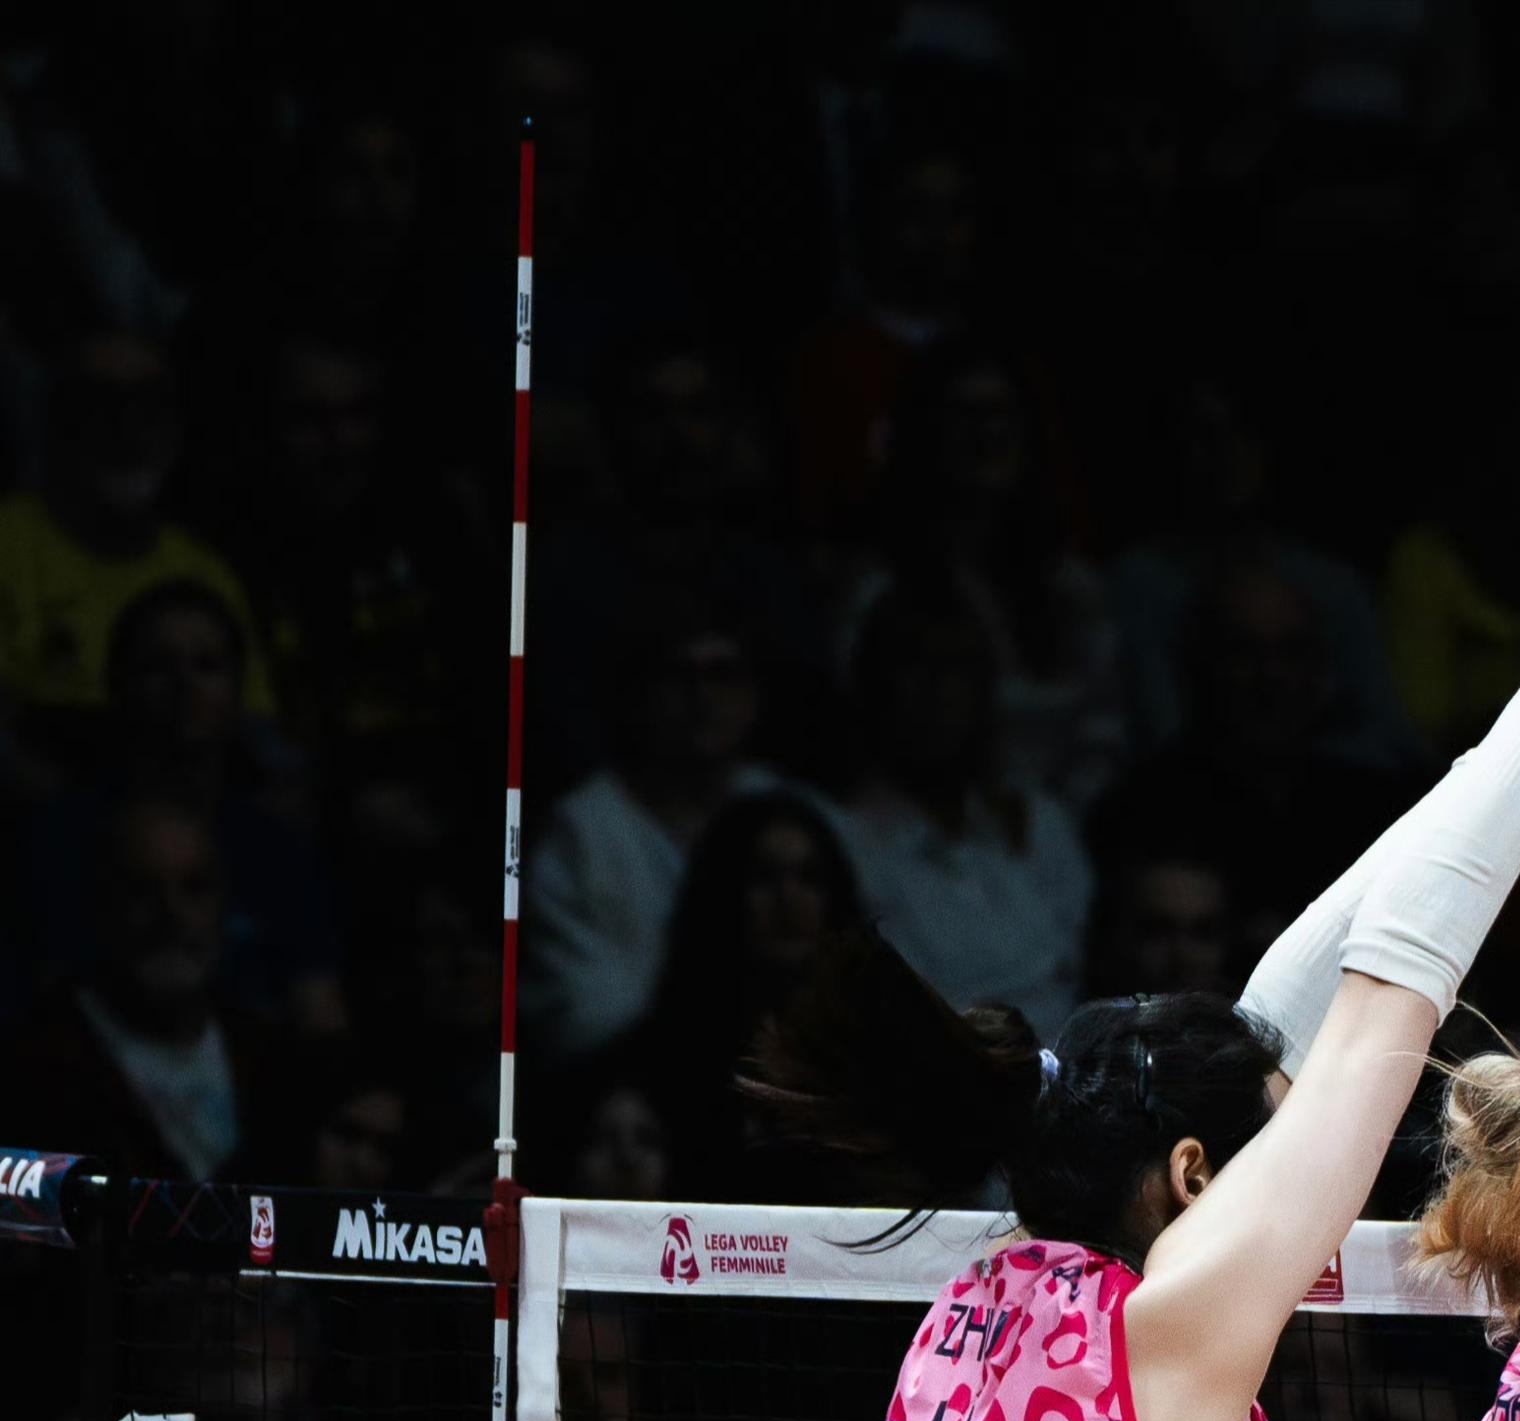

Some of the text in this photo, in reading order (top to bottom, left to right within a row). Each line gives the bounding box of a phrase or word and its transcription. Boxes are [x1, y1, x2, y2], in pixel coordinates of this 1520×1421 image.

[704, 1233, 789, 1255] LEGA VOLLEY
[710, 1255, 786, 1276] FEMMINILE
